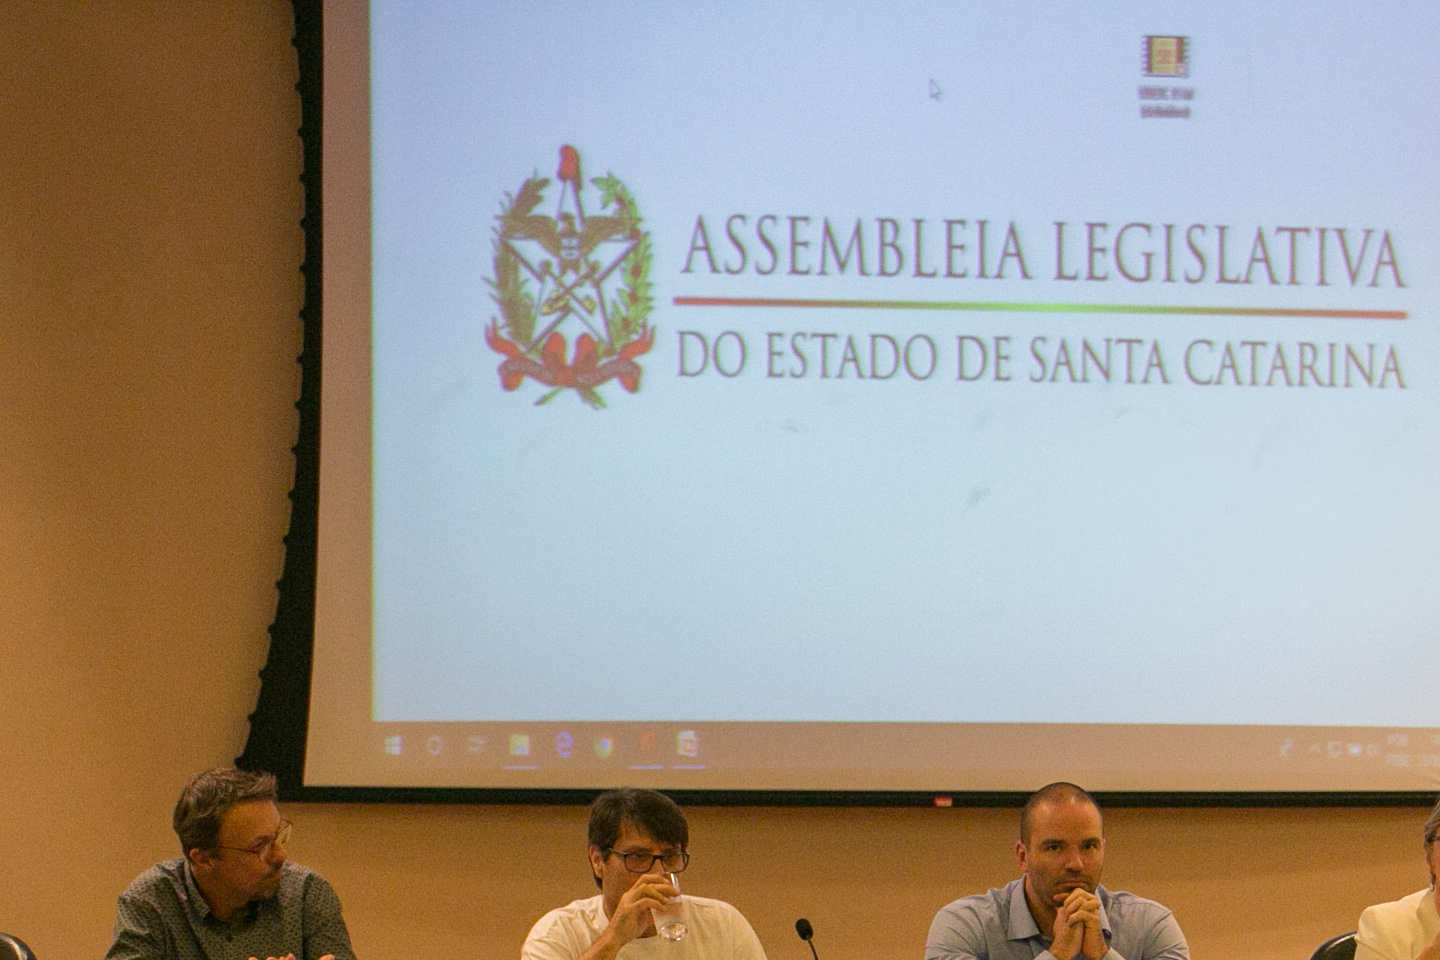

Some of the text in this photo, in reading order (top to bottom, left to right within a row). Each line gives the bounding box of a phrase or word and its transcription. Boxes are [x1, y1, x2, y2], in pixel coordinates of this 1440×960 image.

[680, 212, 1409, 290] ASSEMBLEIA LEGISLATIVA
[677, 330, 748, 380] DO
[764, 331, 938, 383] ESTADO
[955, 335, 1012, 383] DE
[1029, 335, 1172, 387] SANTA
[1183, 338, 1408, 391] CATARINA
